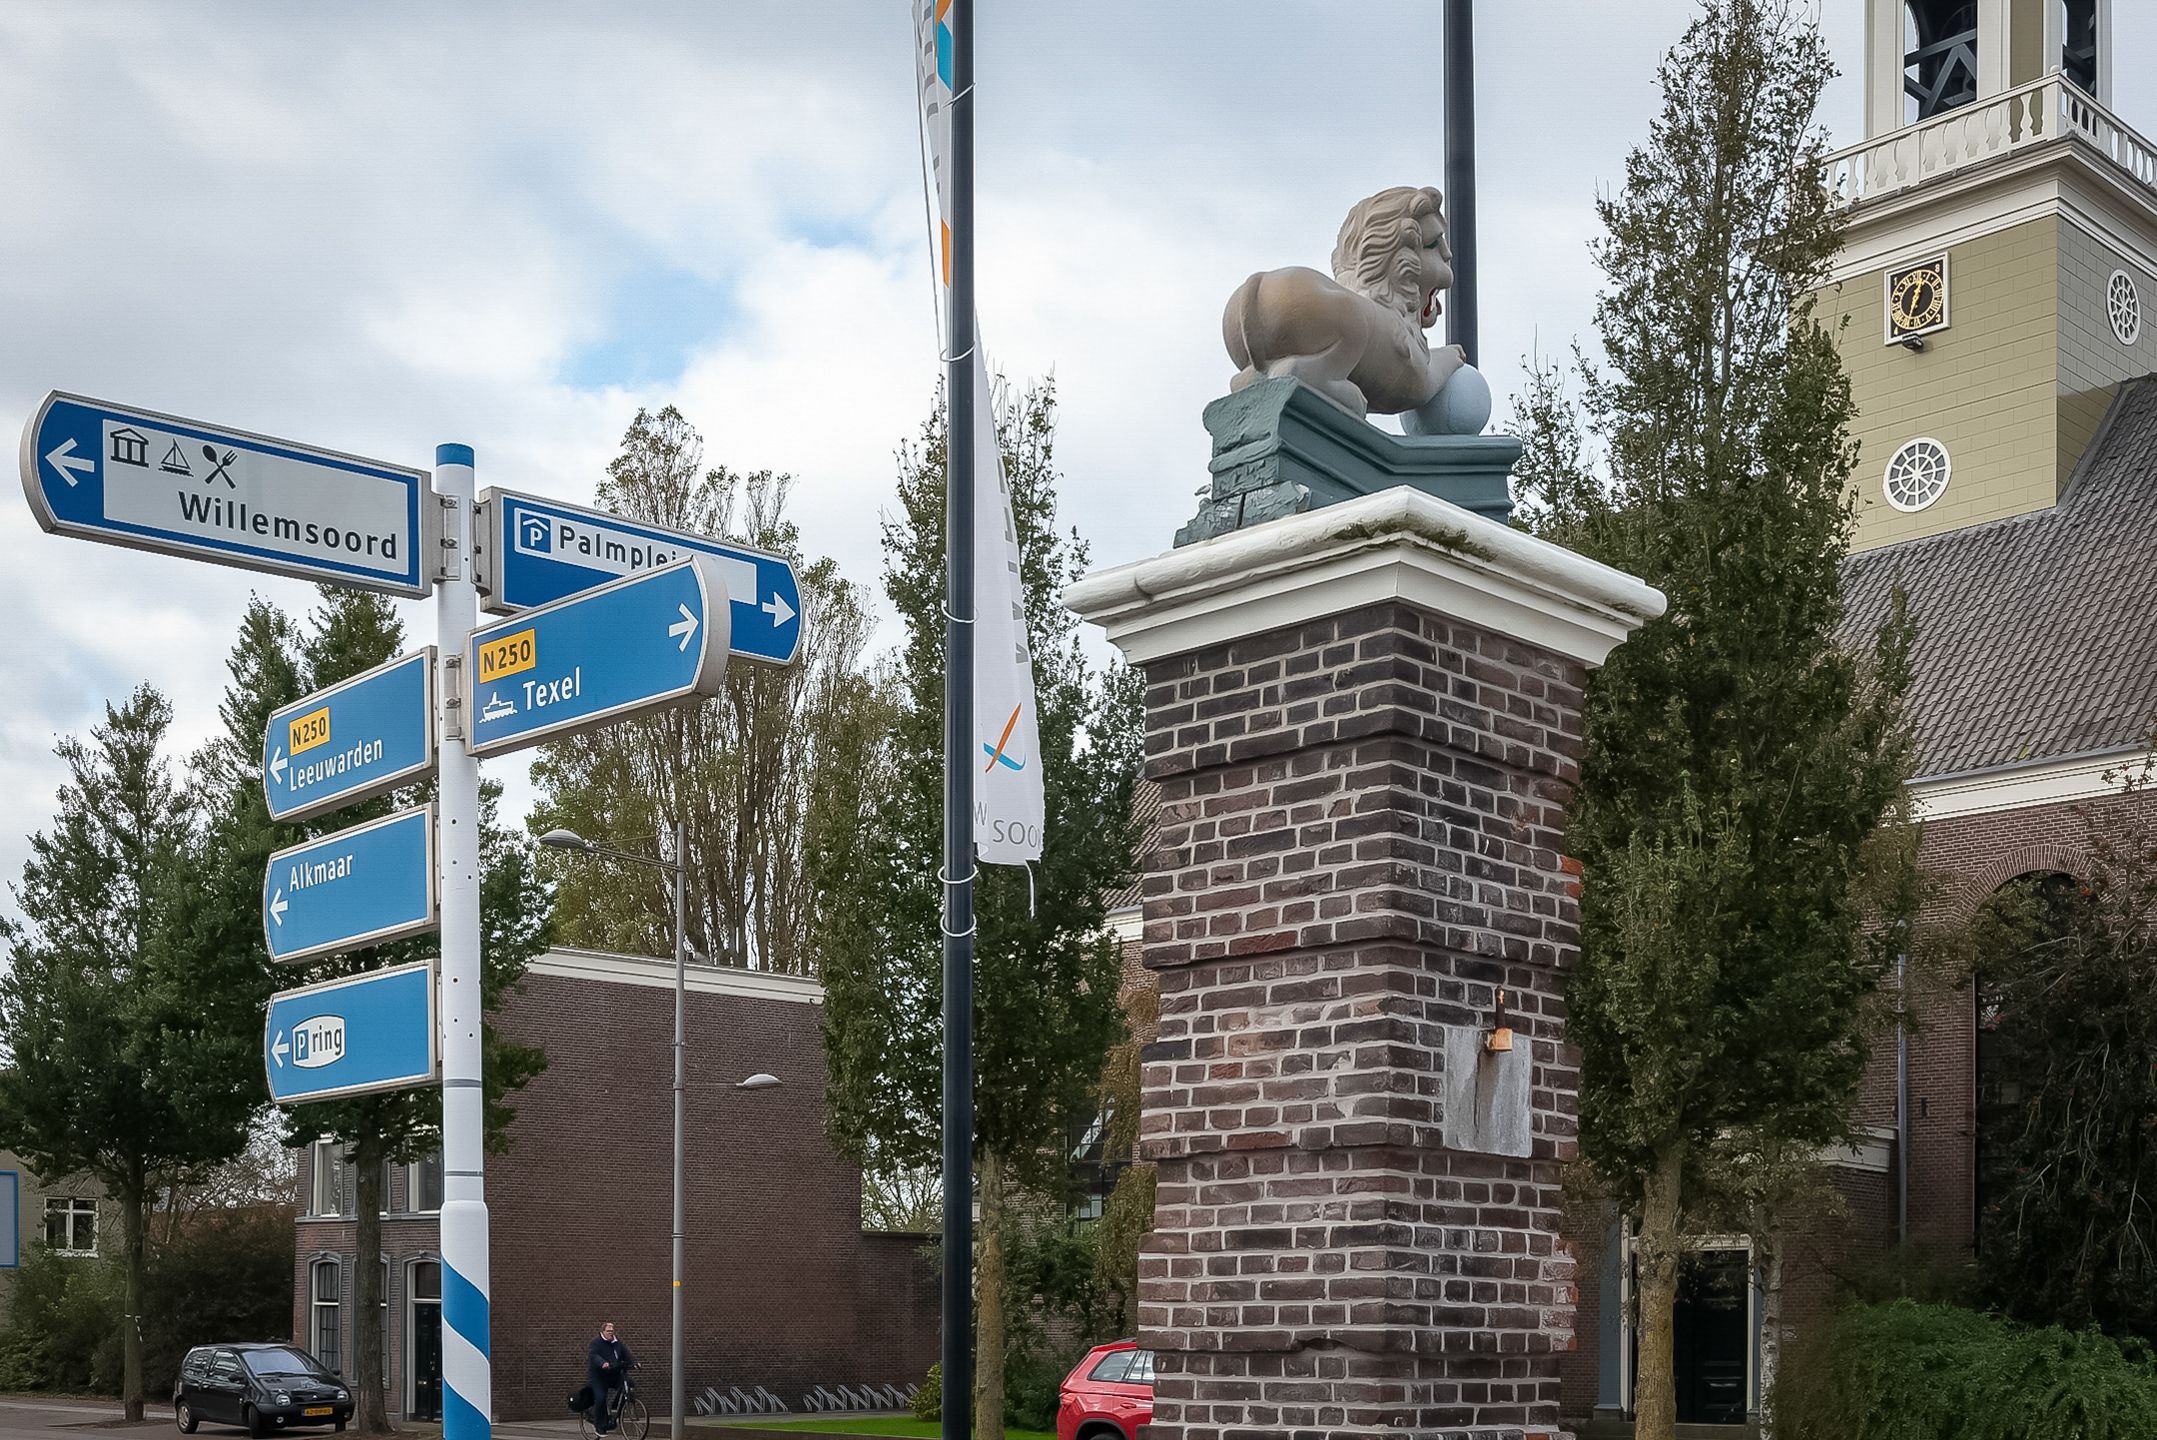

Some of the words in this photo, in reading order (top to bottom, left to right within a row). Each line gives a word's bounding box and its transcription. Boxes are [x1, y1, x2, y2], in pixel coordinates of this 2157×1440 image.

[1935, 263, 1940, 272] 8
[178, 490, 397, 560] Willemsoord
[483, 639, 531, 674] N250
[522, 666, 580, 711] Texel
[292, 716, 326, 748] N250
[290, 738, 383, 792] Leeuwarden
[992, 819, 1041, 849] SOO
[289, 854, 354, 893] Alkmaar
[312, 1024, 342, 1056] ring
